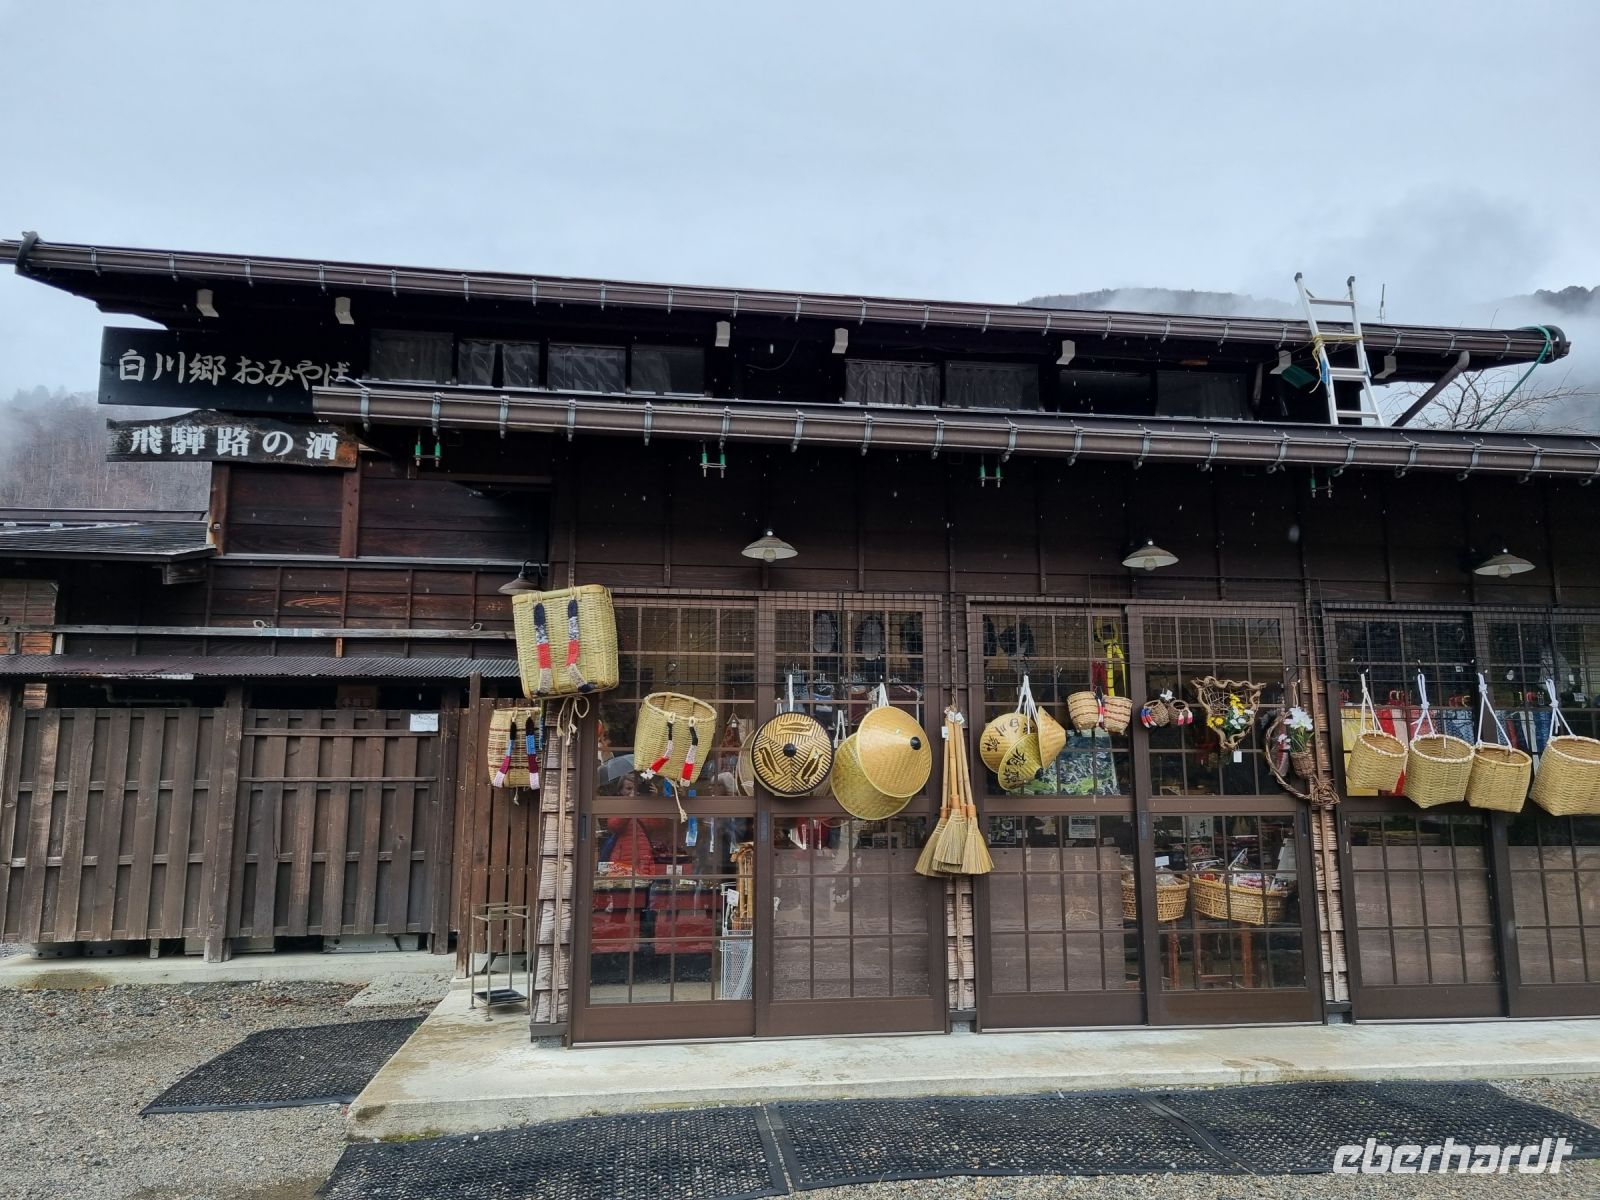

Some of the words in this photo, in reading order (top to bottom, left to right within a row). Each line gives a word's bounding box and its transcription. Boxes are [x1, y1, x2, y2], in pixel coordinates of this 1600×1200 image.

[130, 426, 339, 460] 飛騨路の酒
